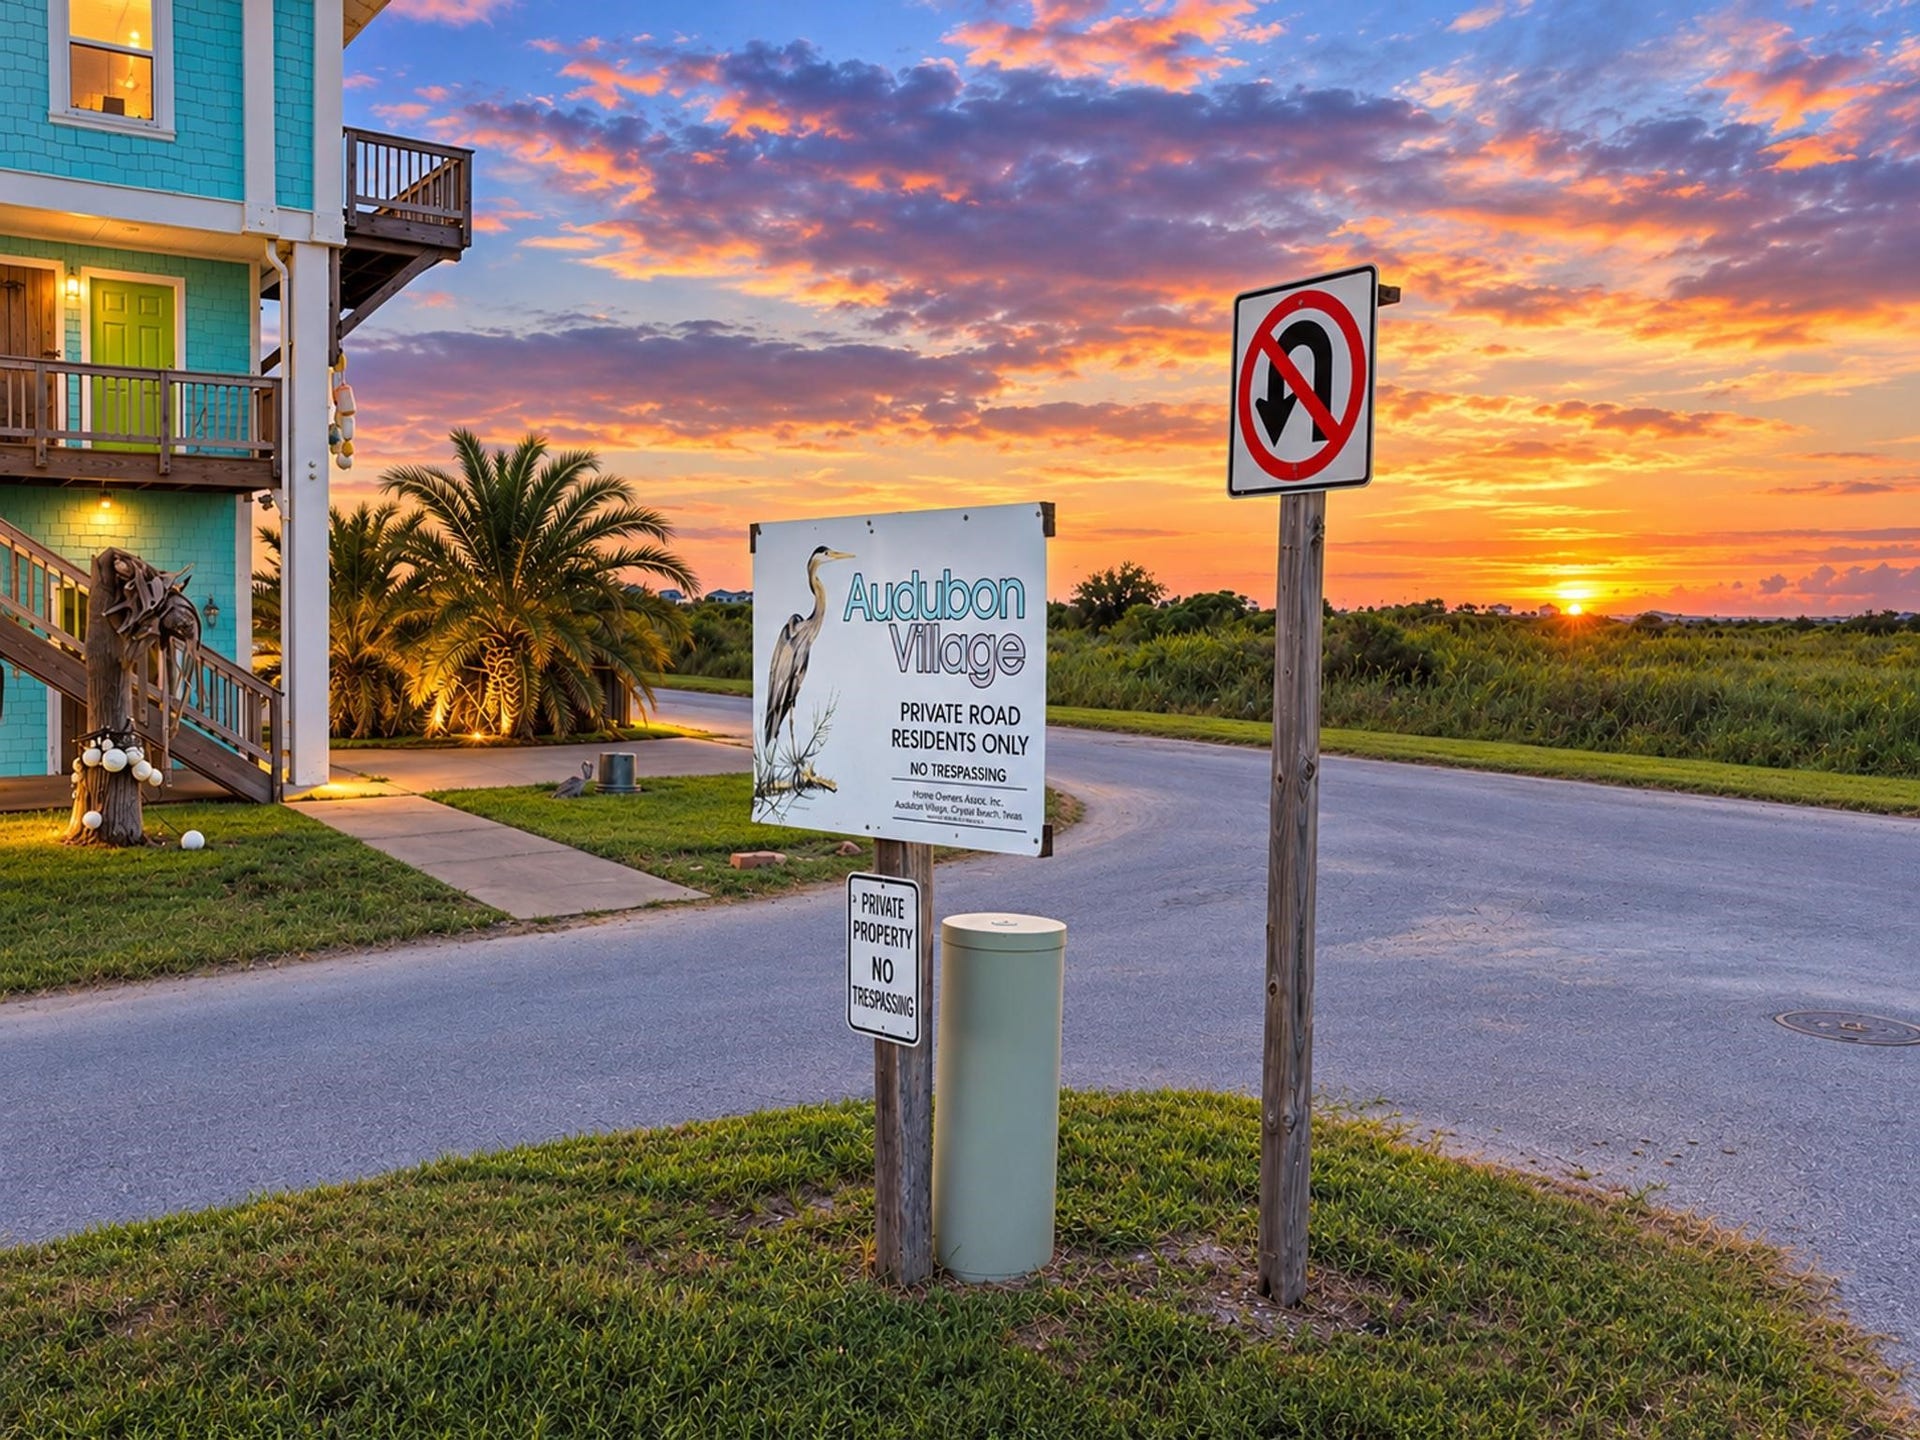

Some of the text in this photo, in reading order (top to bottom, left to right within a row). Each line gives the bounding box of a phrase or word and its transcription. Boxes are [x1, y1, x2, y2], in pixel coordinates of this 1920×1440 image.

[843, 568, 1026, 622] Audubon
[888, 623, 1027, 690] Village
[900, 702, 1021, 726] PRIVATE ROAD
[892, 728, 1029, 756] RESIDENTS ONLY
[910, 762, 1007, 783] NO TRESPASSING
[912, 790, 934, 801] Home
[861, 892, 905, 920] PRIVATE
[853, 920, 914, 950] PROPERTY
[872, 956, 894, 984] NO
[852, 985, 914, 1018] TRESPASSING
